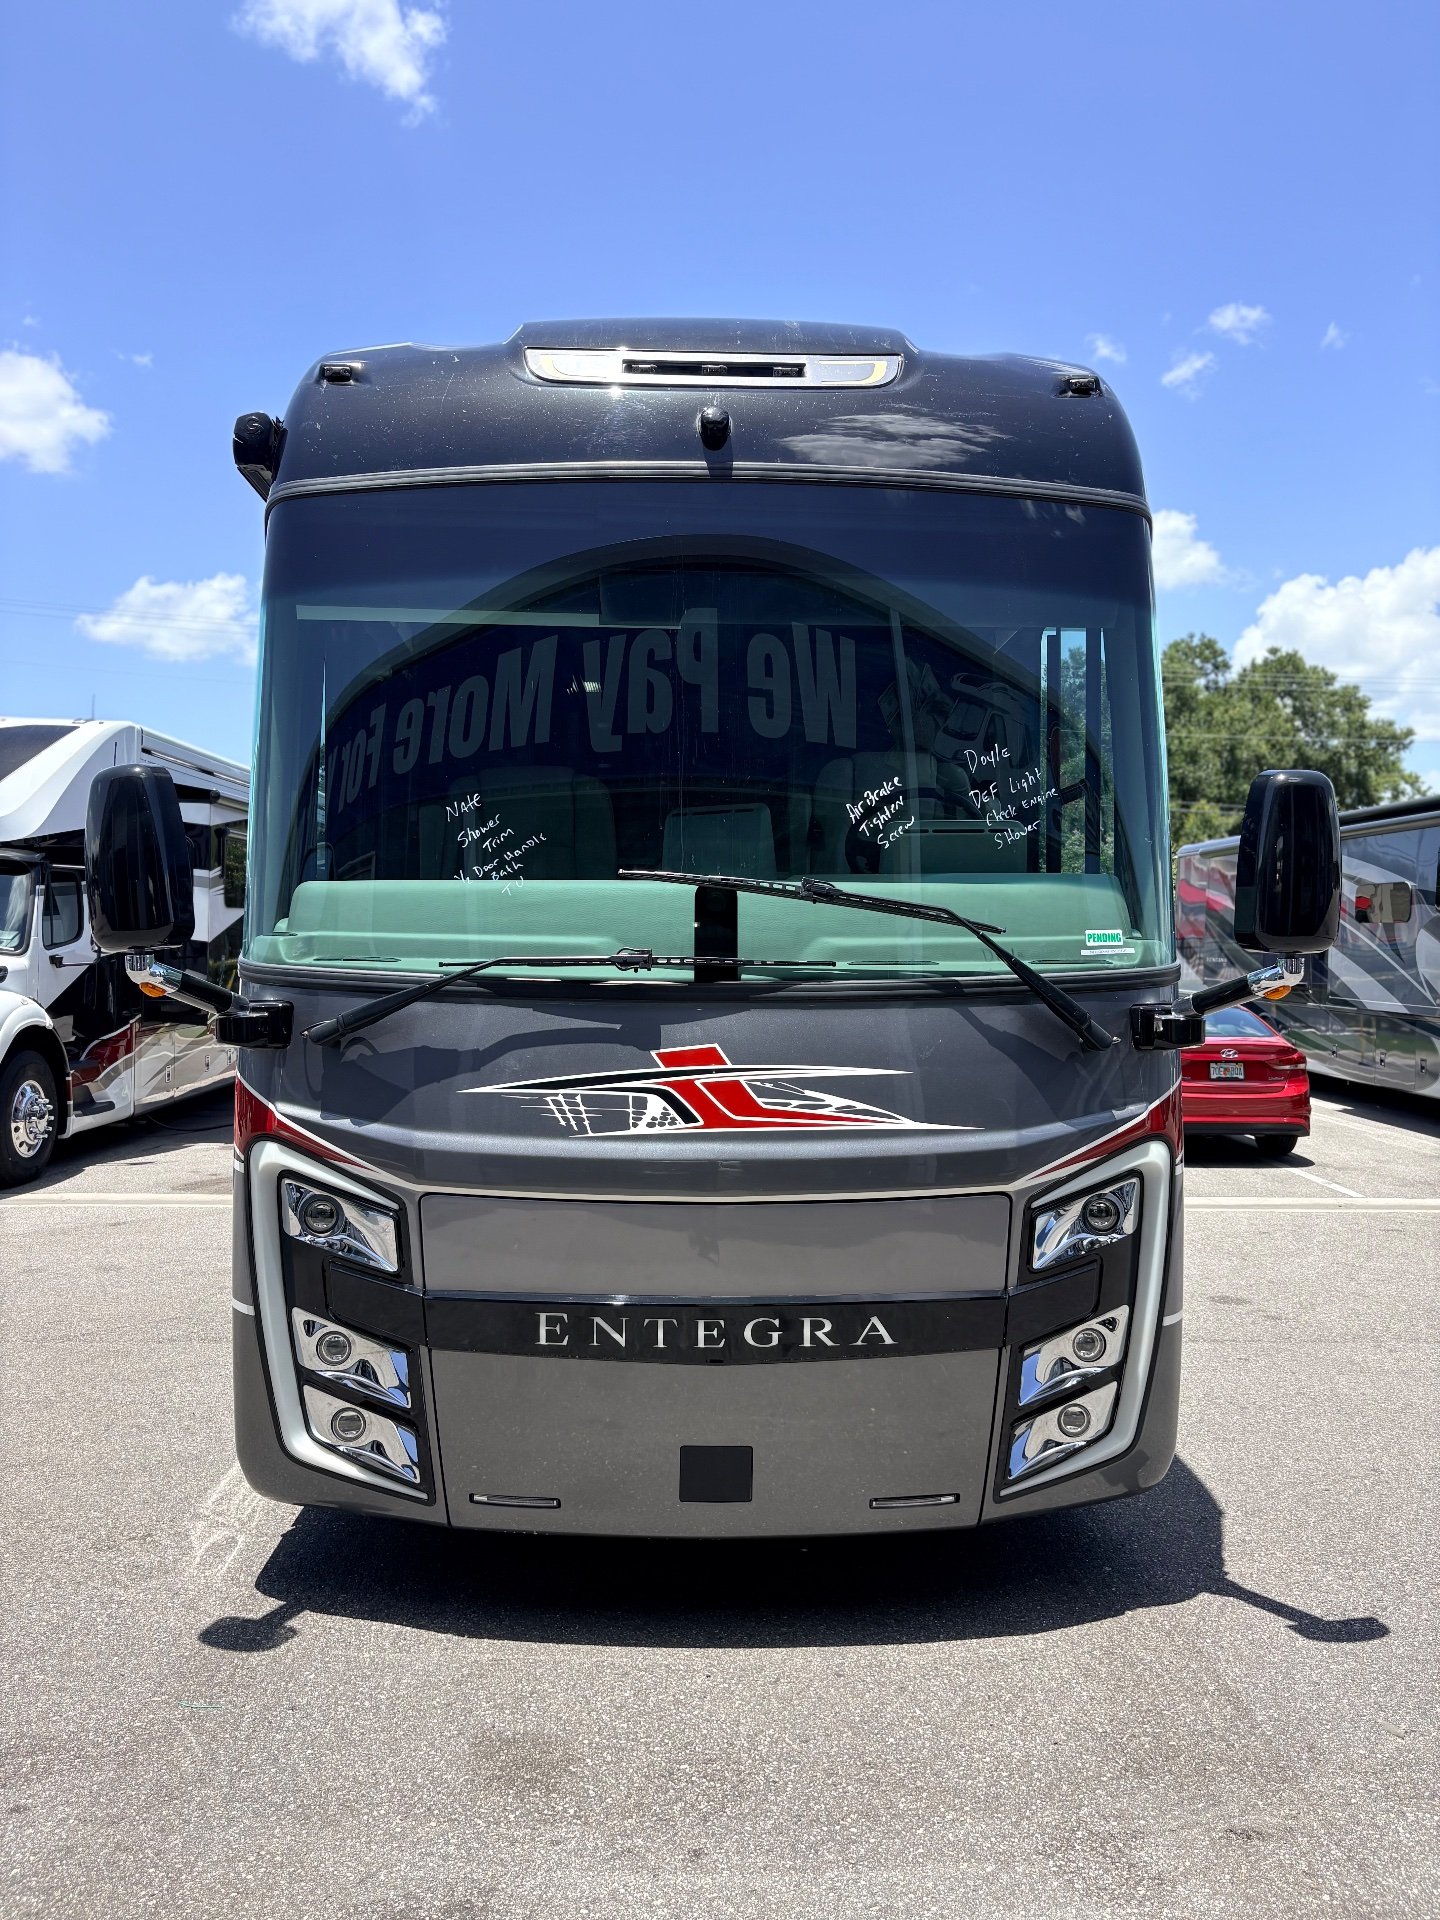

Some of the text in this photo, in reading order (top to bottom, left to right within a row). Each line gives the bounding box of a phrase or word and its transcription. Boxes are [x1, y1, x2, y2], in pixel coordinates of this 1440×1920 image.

[968, 767, 1042, 809] DEF Light
[457, 813, 501, 848] Shower
[482, 828, 515, 853] Trim
[877, 815, 915, 849] Screw
[472, 858, 500, 878] Door
[490, 860, 524, 881] Bath
[1087, 932, 1122, 943] PENDING
[534, 1312, 899, 1348] ENTEGRA
